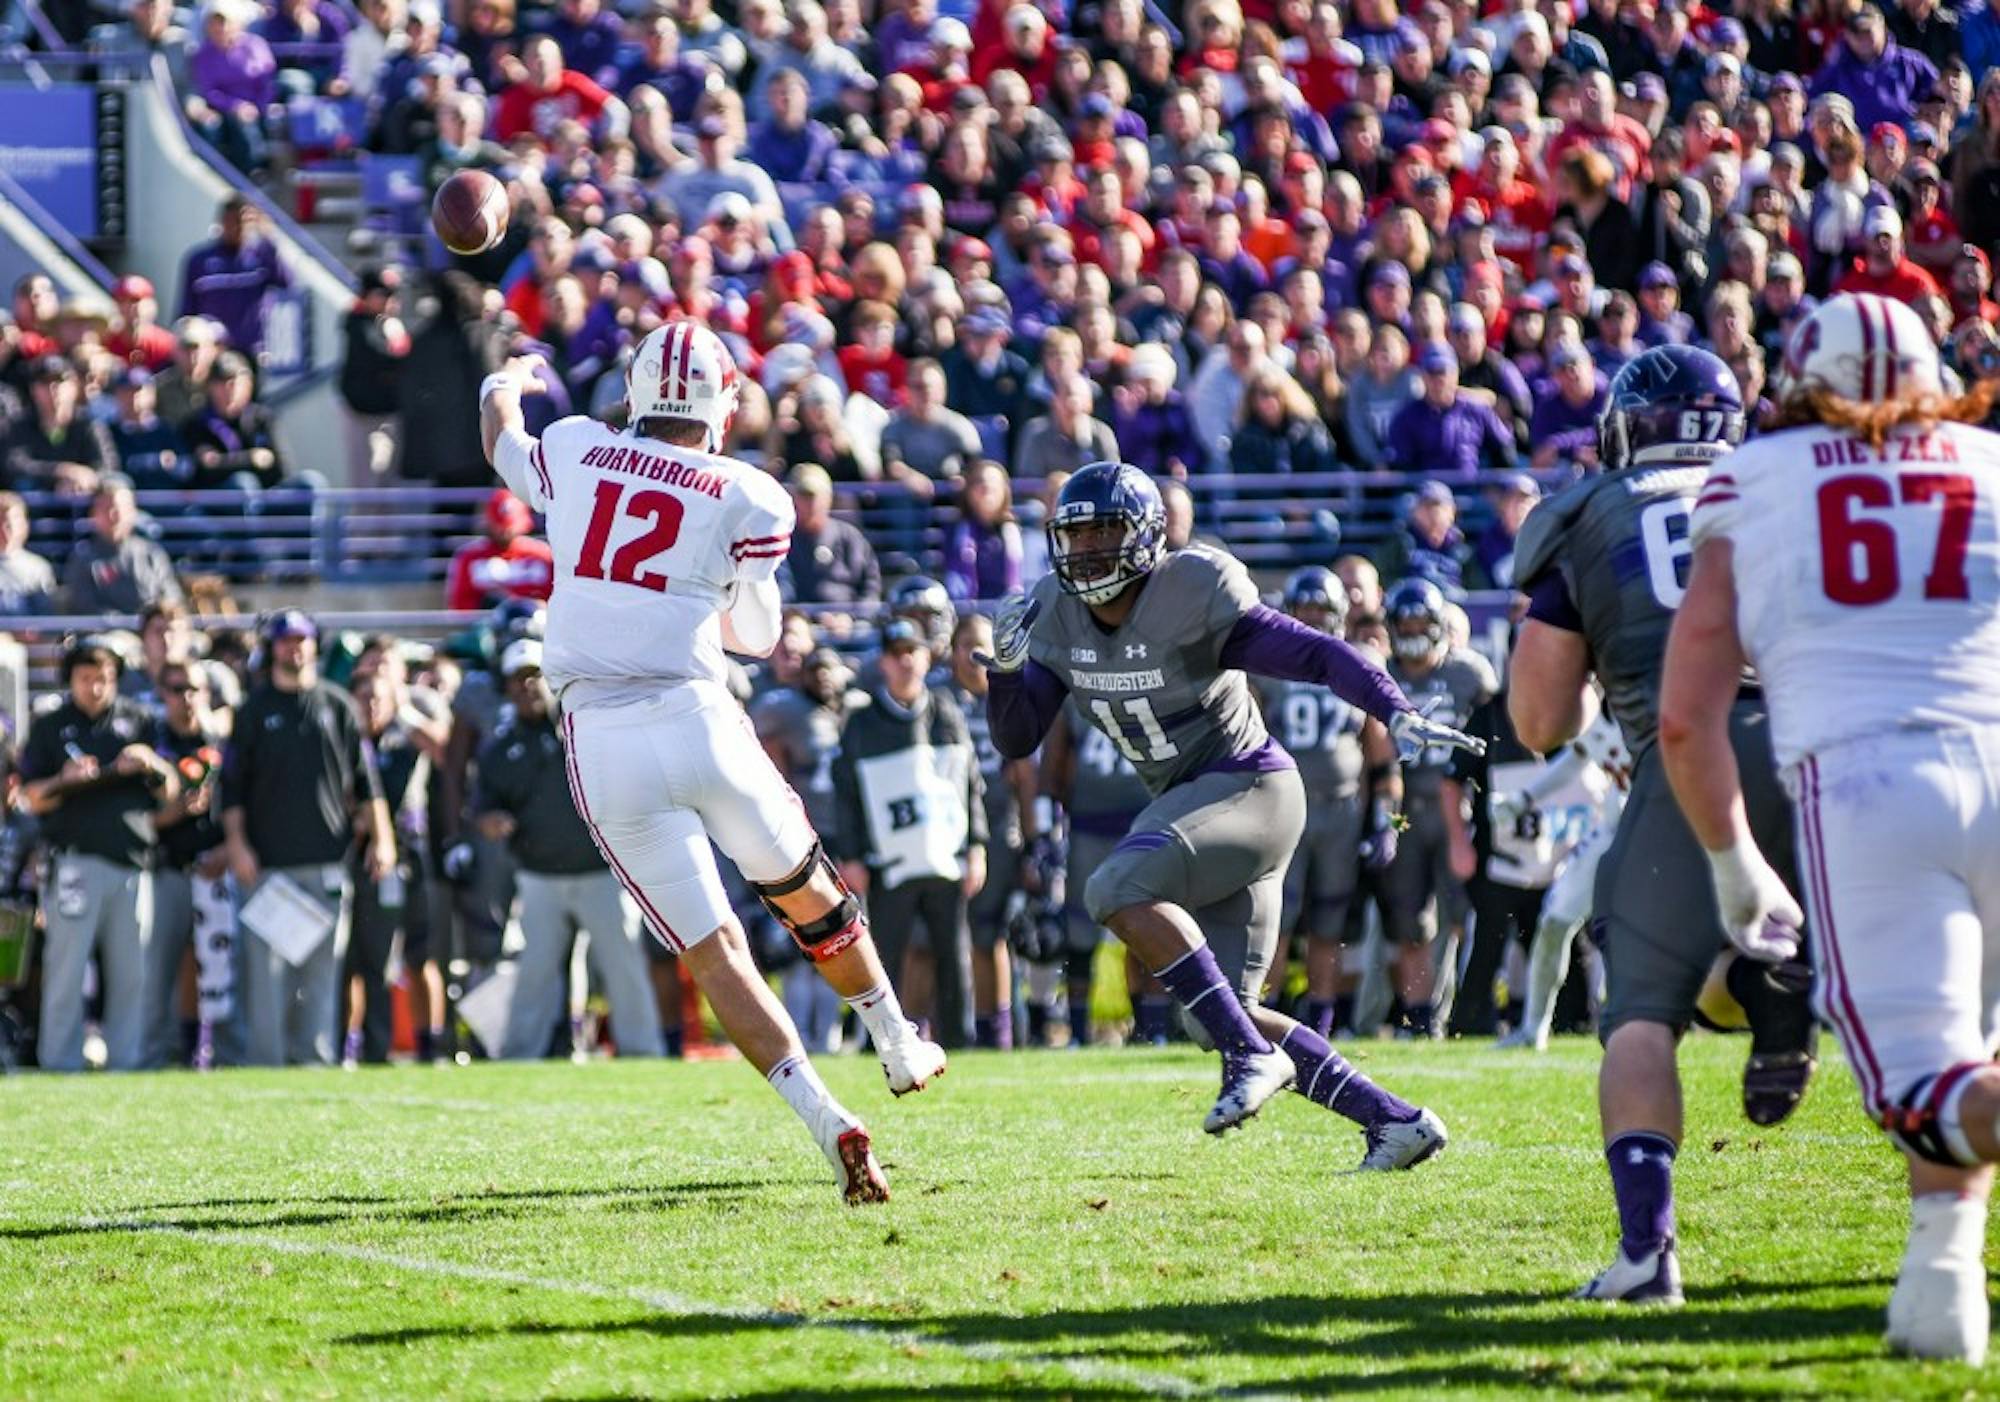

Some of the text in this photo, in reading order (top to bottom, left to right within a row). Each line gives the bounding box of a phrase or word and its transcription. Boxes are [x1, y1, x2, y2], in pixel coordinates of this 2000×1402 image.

[1680, 410, 1724, 441] 67
[580, 445, 730, 500] HORNIBROOK
[574, 479, 685, 592] 12
[1816, 472, 1977, 608] 67
[1090, 696, 1180, 761] 11
